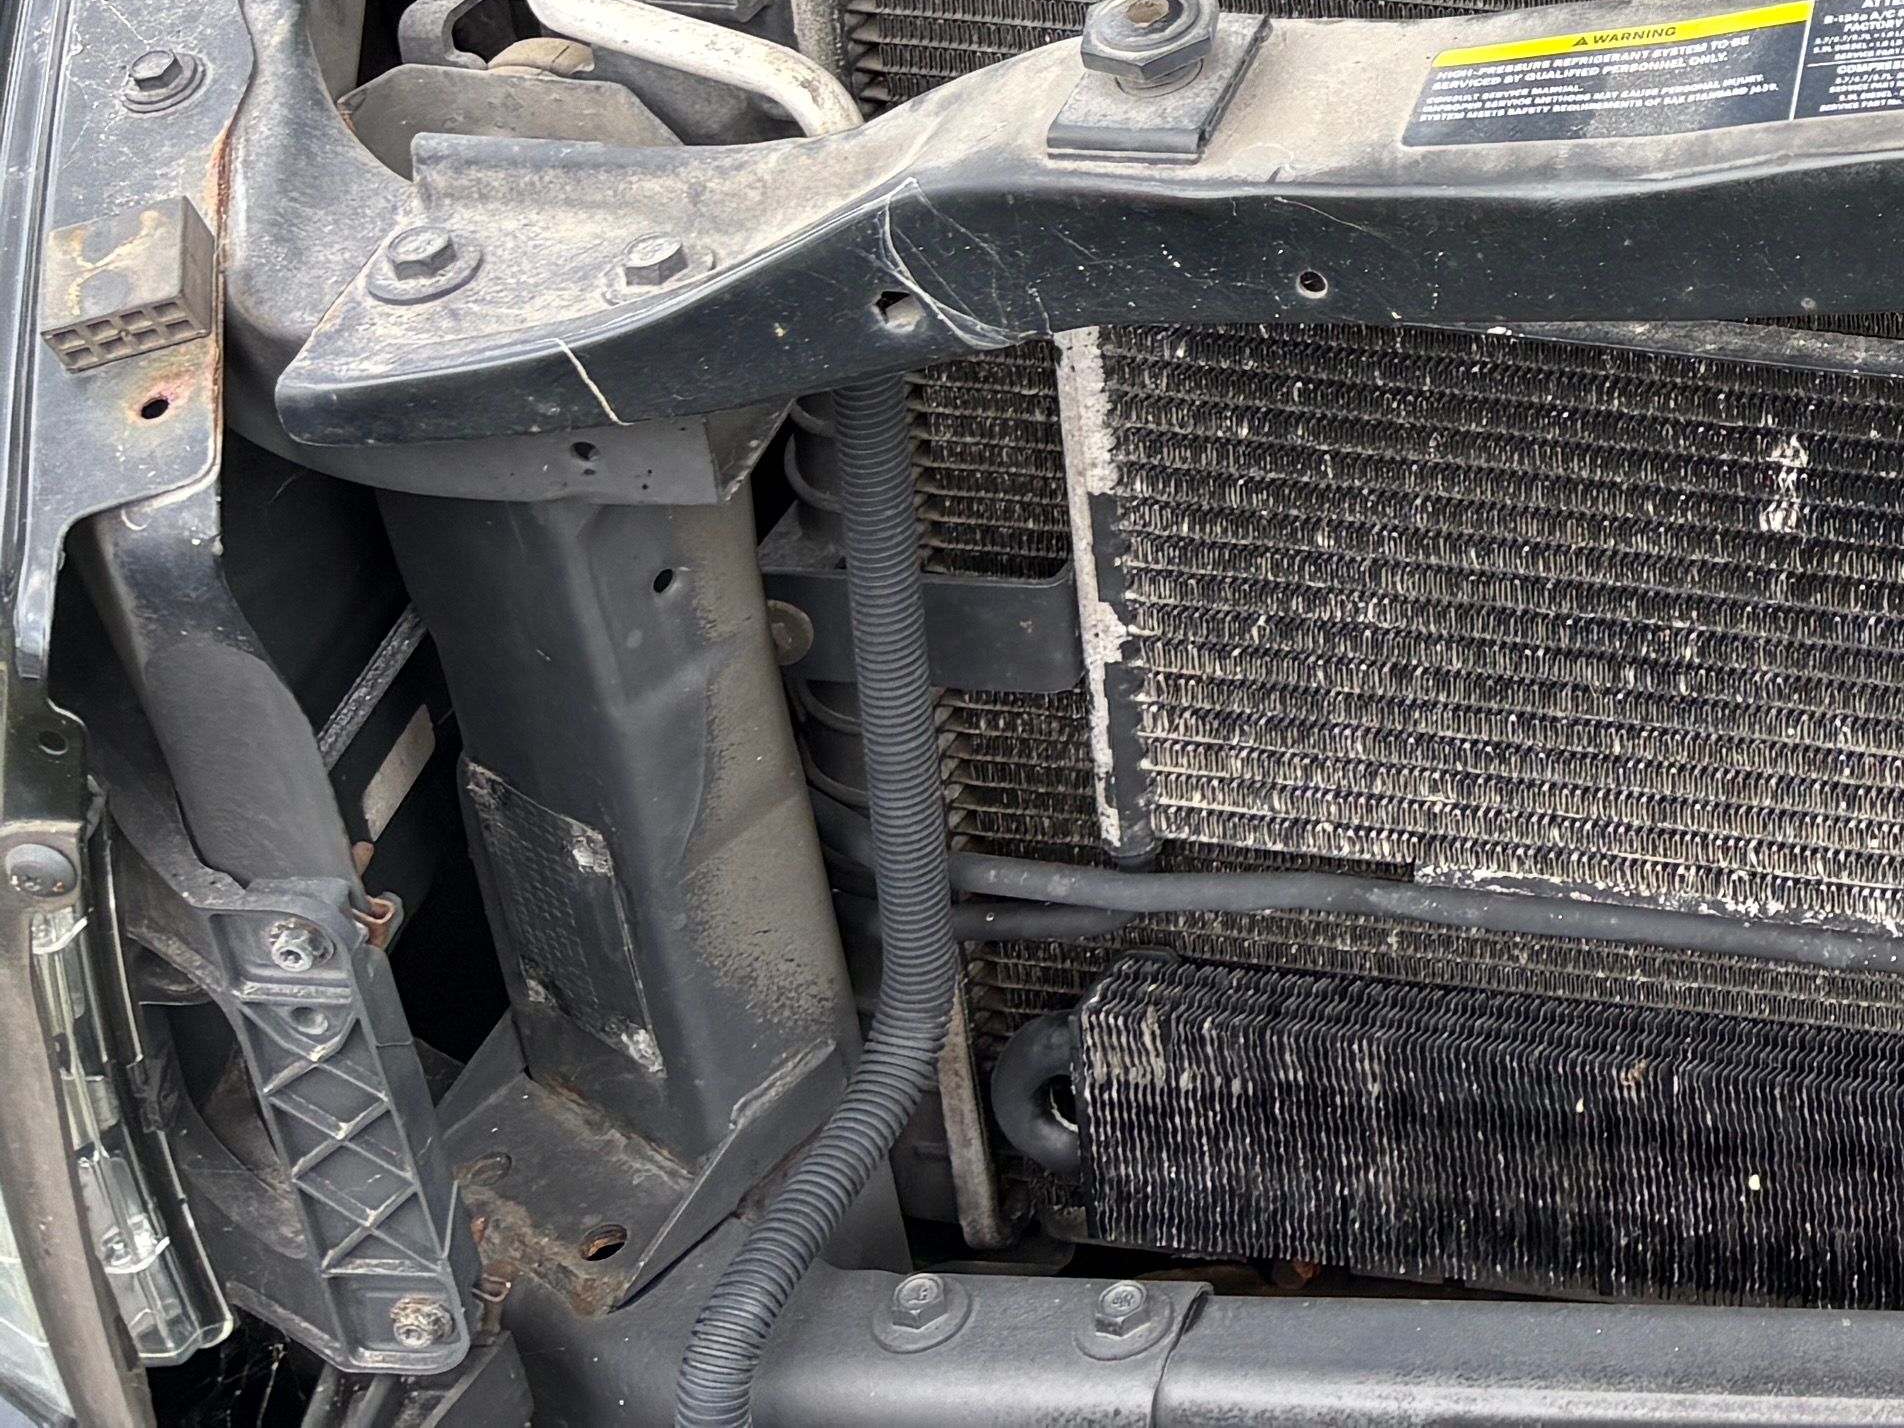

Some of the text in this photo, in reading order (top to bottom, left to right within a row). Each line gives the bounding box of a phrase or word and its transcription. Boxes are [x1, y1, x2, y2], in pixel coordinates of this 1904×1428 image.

[1870, 9, 1896, 21] A/C
[1593, 26, 1677, 44] WARNING
[1843, 19, 1904, 33] FACTORY
[1552, 50, 1650, 68] REFRIGERANT
[1651, 41, 1708, 58] SYSTEM
[1709, 39, 1729, 51] TO
[1729, 35, 1750, 46] BE
[1432, 76, 1502, 91] SERVICED
[1503, 73, 1523, 85] BY
[1524, 66, 1600, 82] QUALIFIED
[1602, 58, 1687, 75] PERSONNEL
